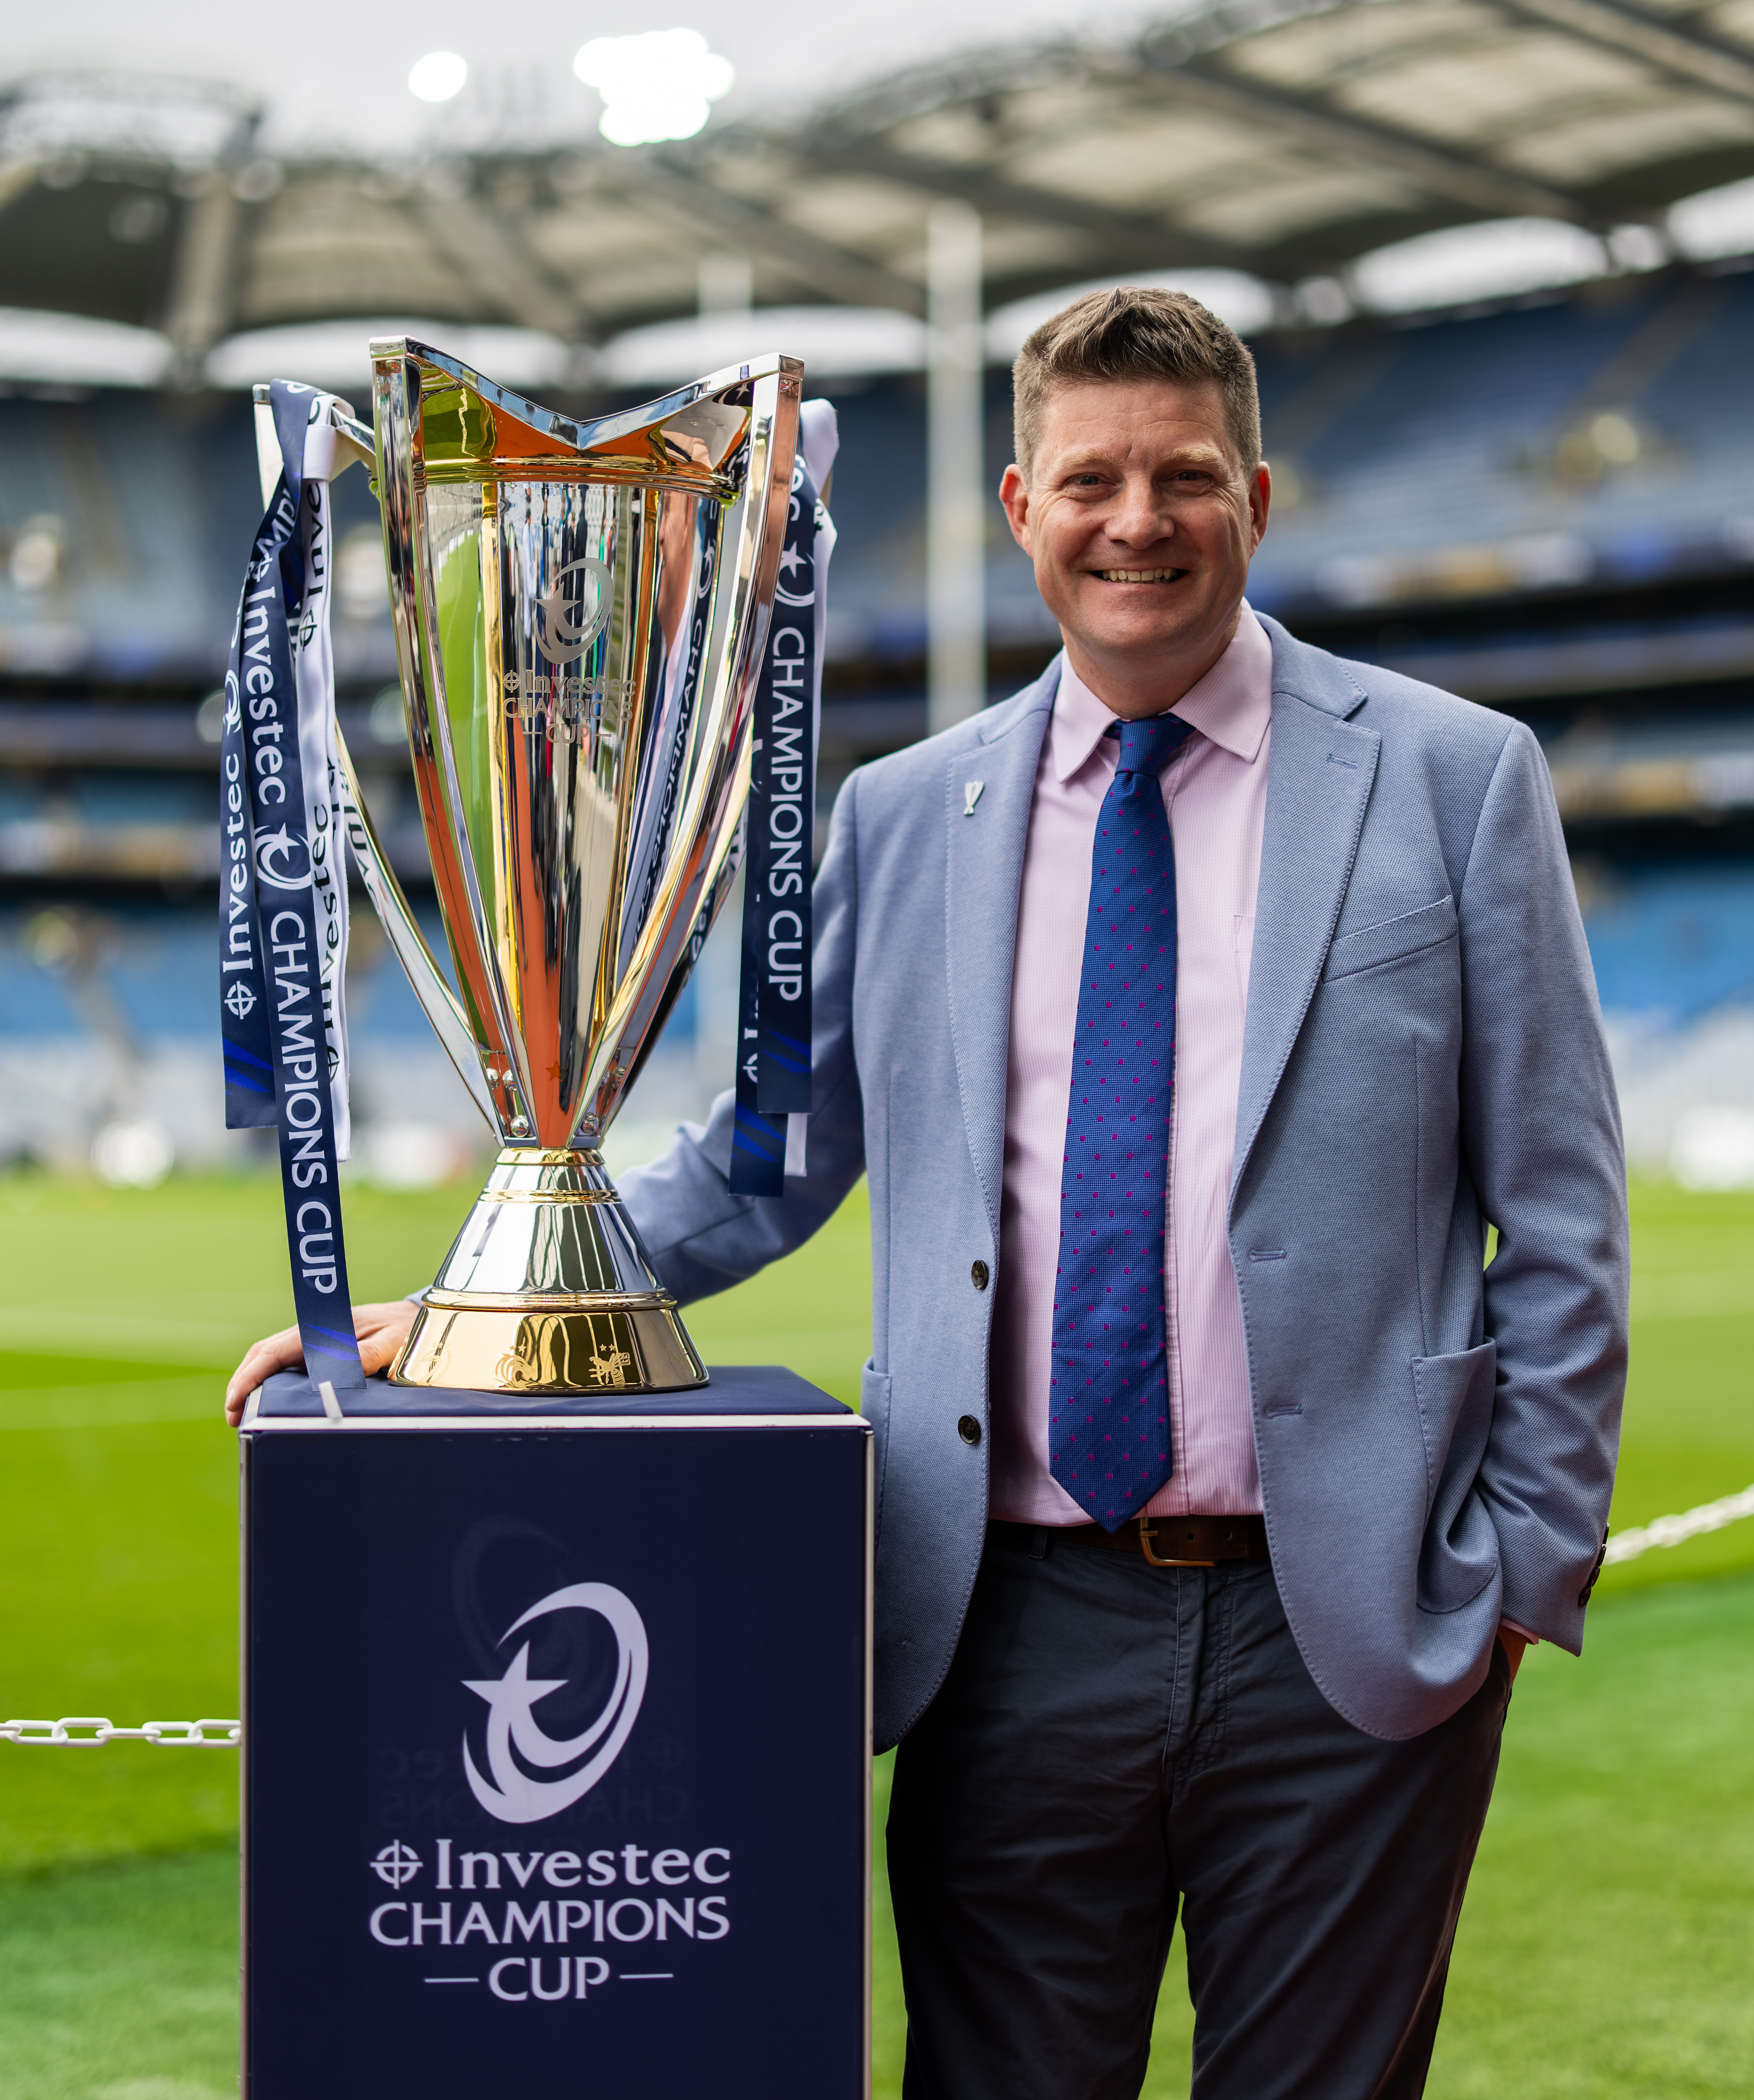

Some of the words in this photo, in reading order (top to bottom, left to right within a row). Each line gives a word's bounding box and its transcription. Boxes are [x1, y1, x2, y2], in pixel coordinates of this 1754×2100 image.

[243, 586, 286, 805] Investec
[503, 697, 633, 721] CHAMPIONS
[526, 669, 636, 696] Investec
[545, 723, 591, 744] CUP
[770, 627, 805, 897] CHAMPIONS
[222, 753, 253, 973] Investec
[768, 910, 802, 1000] CUP
[270, 911, 326, 1188] CHAMPIONS
[297, 1201, 337, 1294] CUP
[436, 1839, 730, 1889] Investec
[370, 1896, 730, 1946] CHAMPIONS
[489, 1956, 609, 2001] CUP
